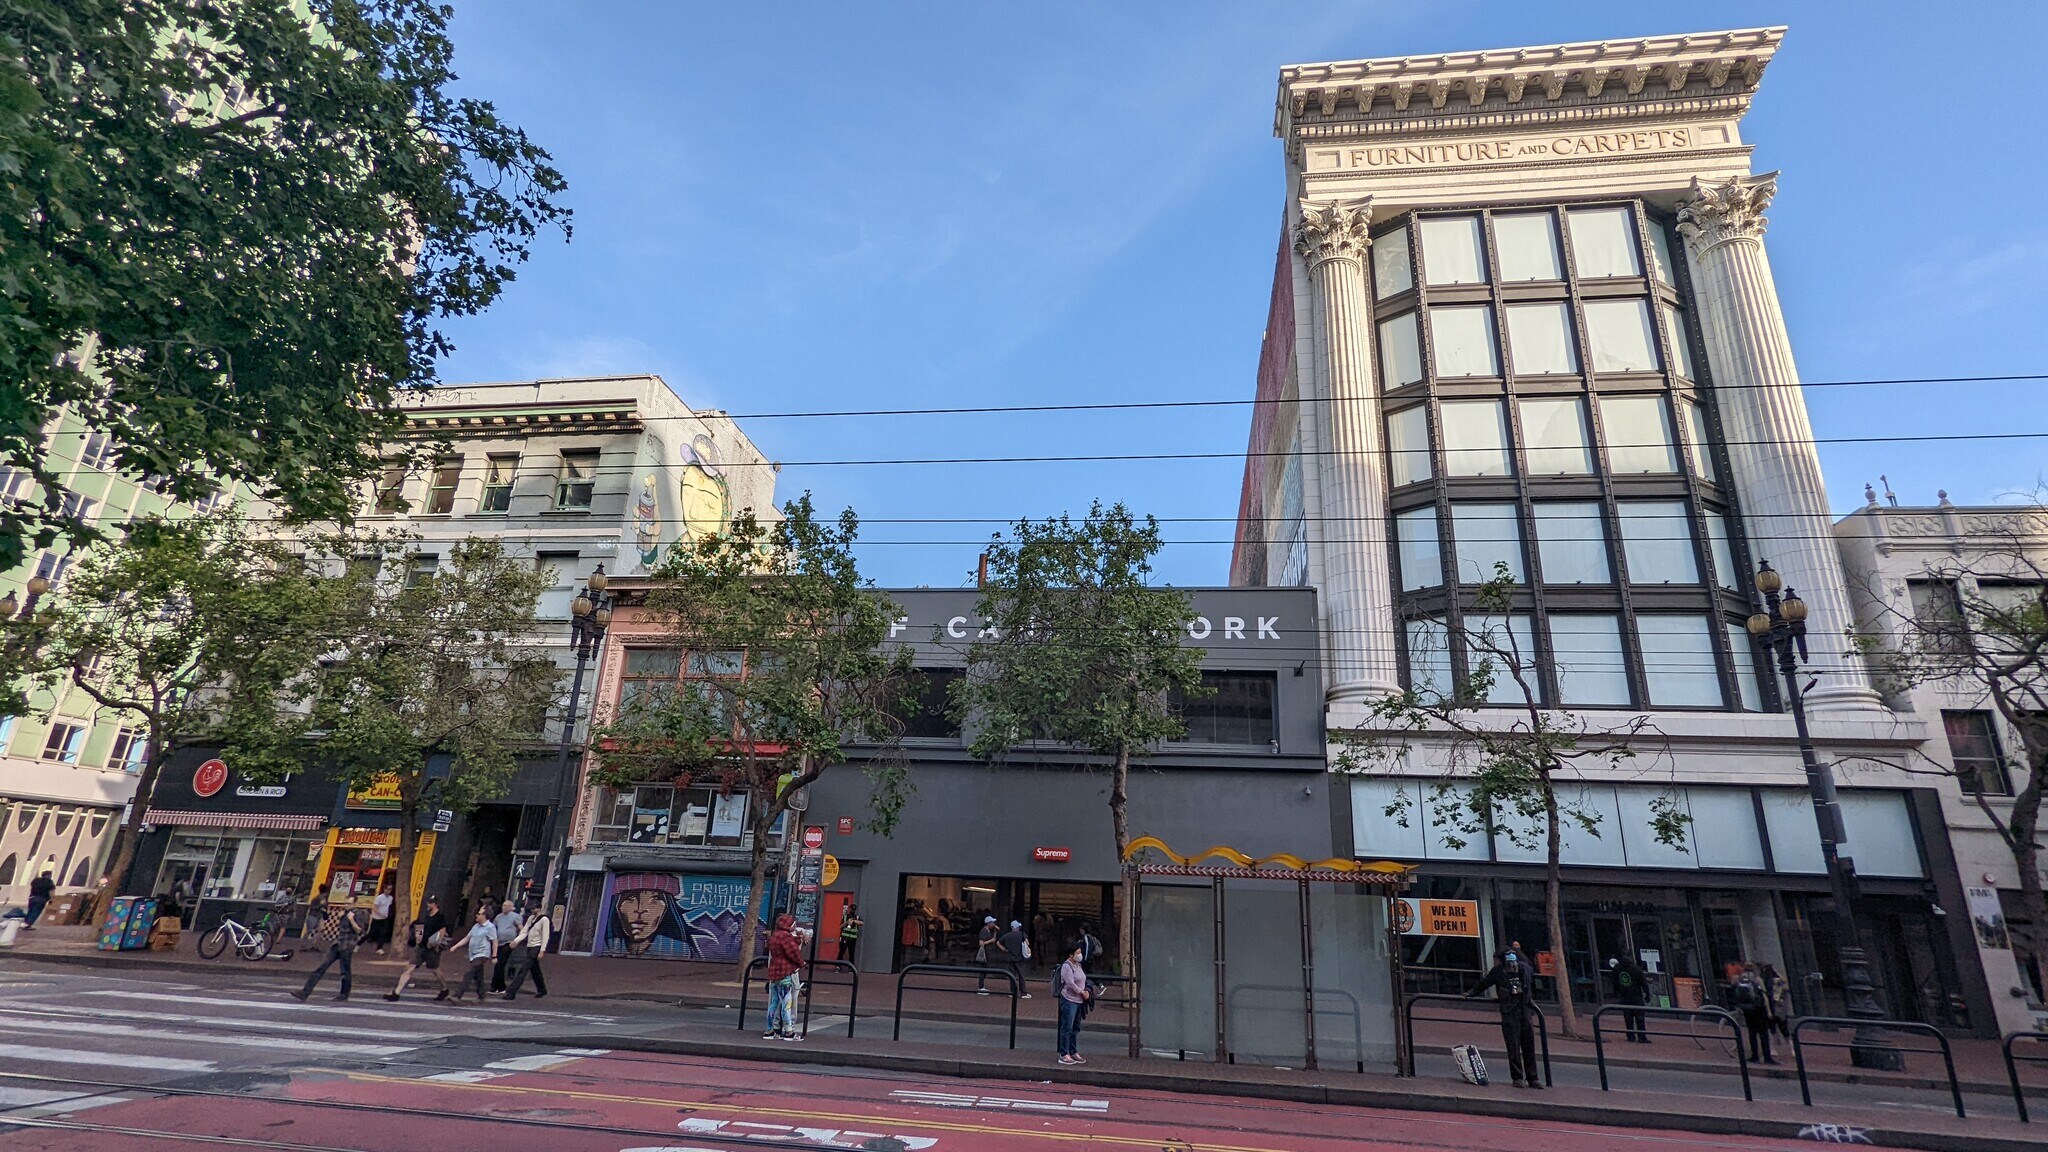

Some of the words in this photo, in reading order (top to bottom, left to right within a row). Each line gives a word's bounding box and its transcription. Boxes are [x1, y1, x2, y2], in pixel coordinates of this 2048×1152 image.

[1351, 141, 1513, 168] FURNITURE
[1518, 144, 1547, 154] AND
[1552, 130, 1687, 155] CARPETS
[1150, 616, 1281, 640] ORK
[370, 787, 401, 797] CAN-C
[1036, 847, 1068, 858] Supreme
[692, 883, 751, 895] ORIGINA
[1432, 906, 1446, 916] WE
[1449, 906, 1466, 917] ARE
[1434, 921, 1457, 931] OPEN
